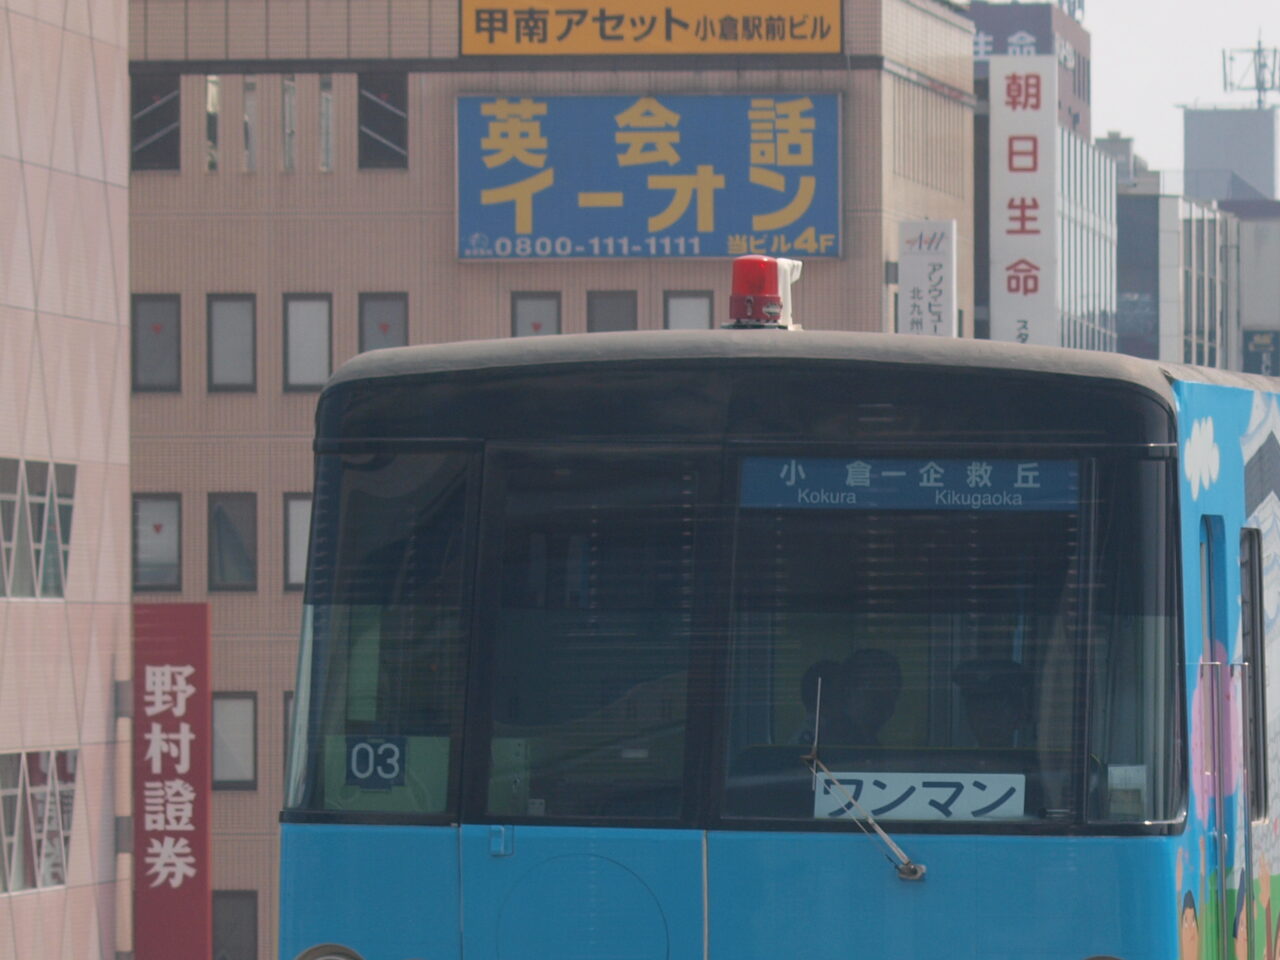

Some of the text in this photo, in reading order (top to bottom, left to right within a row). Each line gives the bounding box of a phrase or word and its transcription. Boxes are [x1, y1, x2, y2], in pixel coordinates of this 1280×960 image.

[475, 7, 832, 44] 甲南アセット 小倉駅前ビル
[480, 96, 817, 169] 英会話
[480, 164, 817, 235] イーオン
[1004, 72, 1041, 296] 朝日生命
[494, 236, 700, 257] 0800-111-1111
[728, 227, 835, 254] 当ビル4F
[909, 287, 923, 332] 北九州
[797, 488, 1023, 509] Kokura Kikugaoka
[143, 664, 197, 889] 野村證券
[351, 742, 400, 779] 03
[824, 778, 1017, 818] ワンマン
